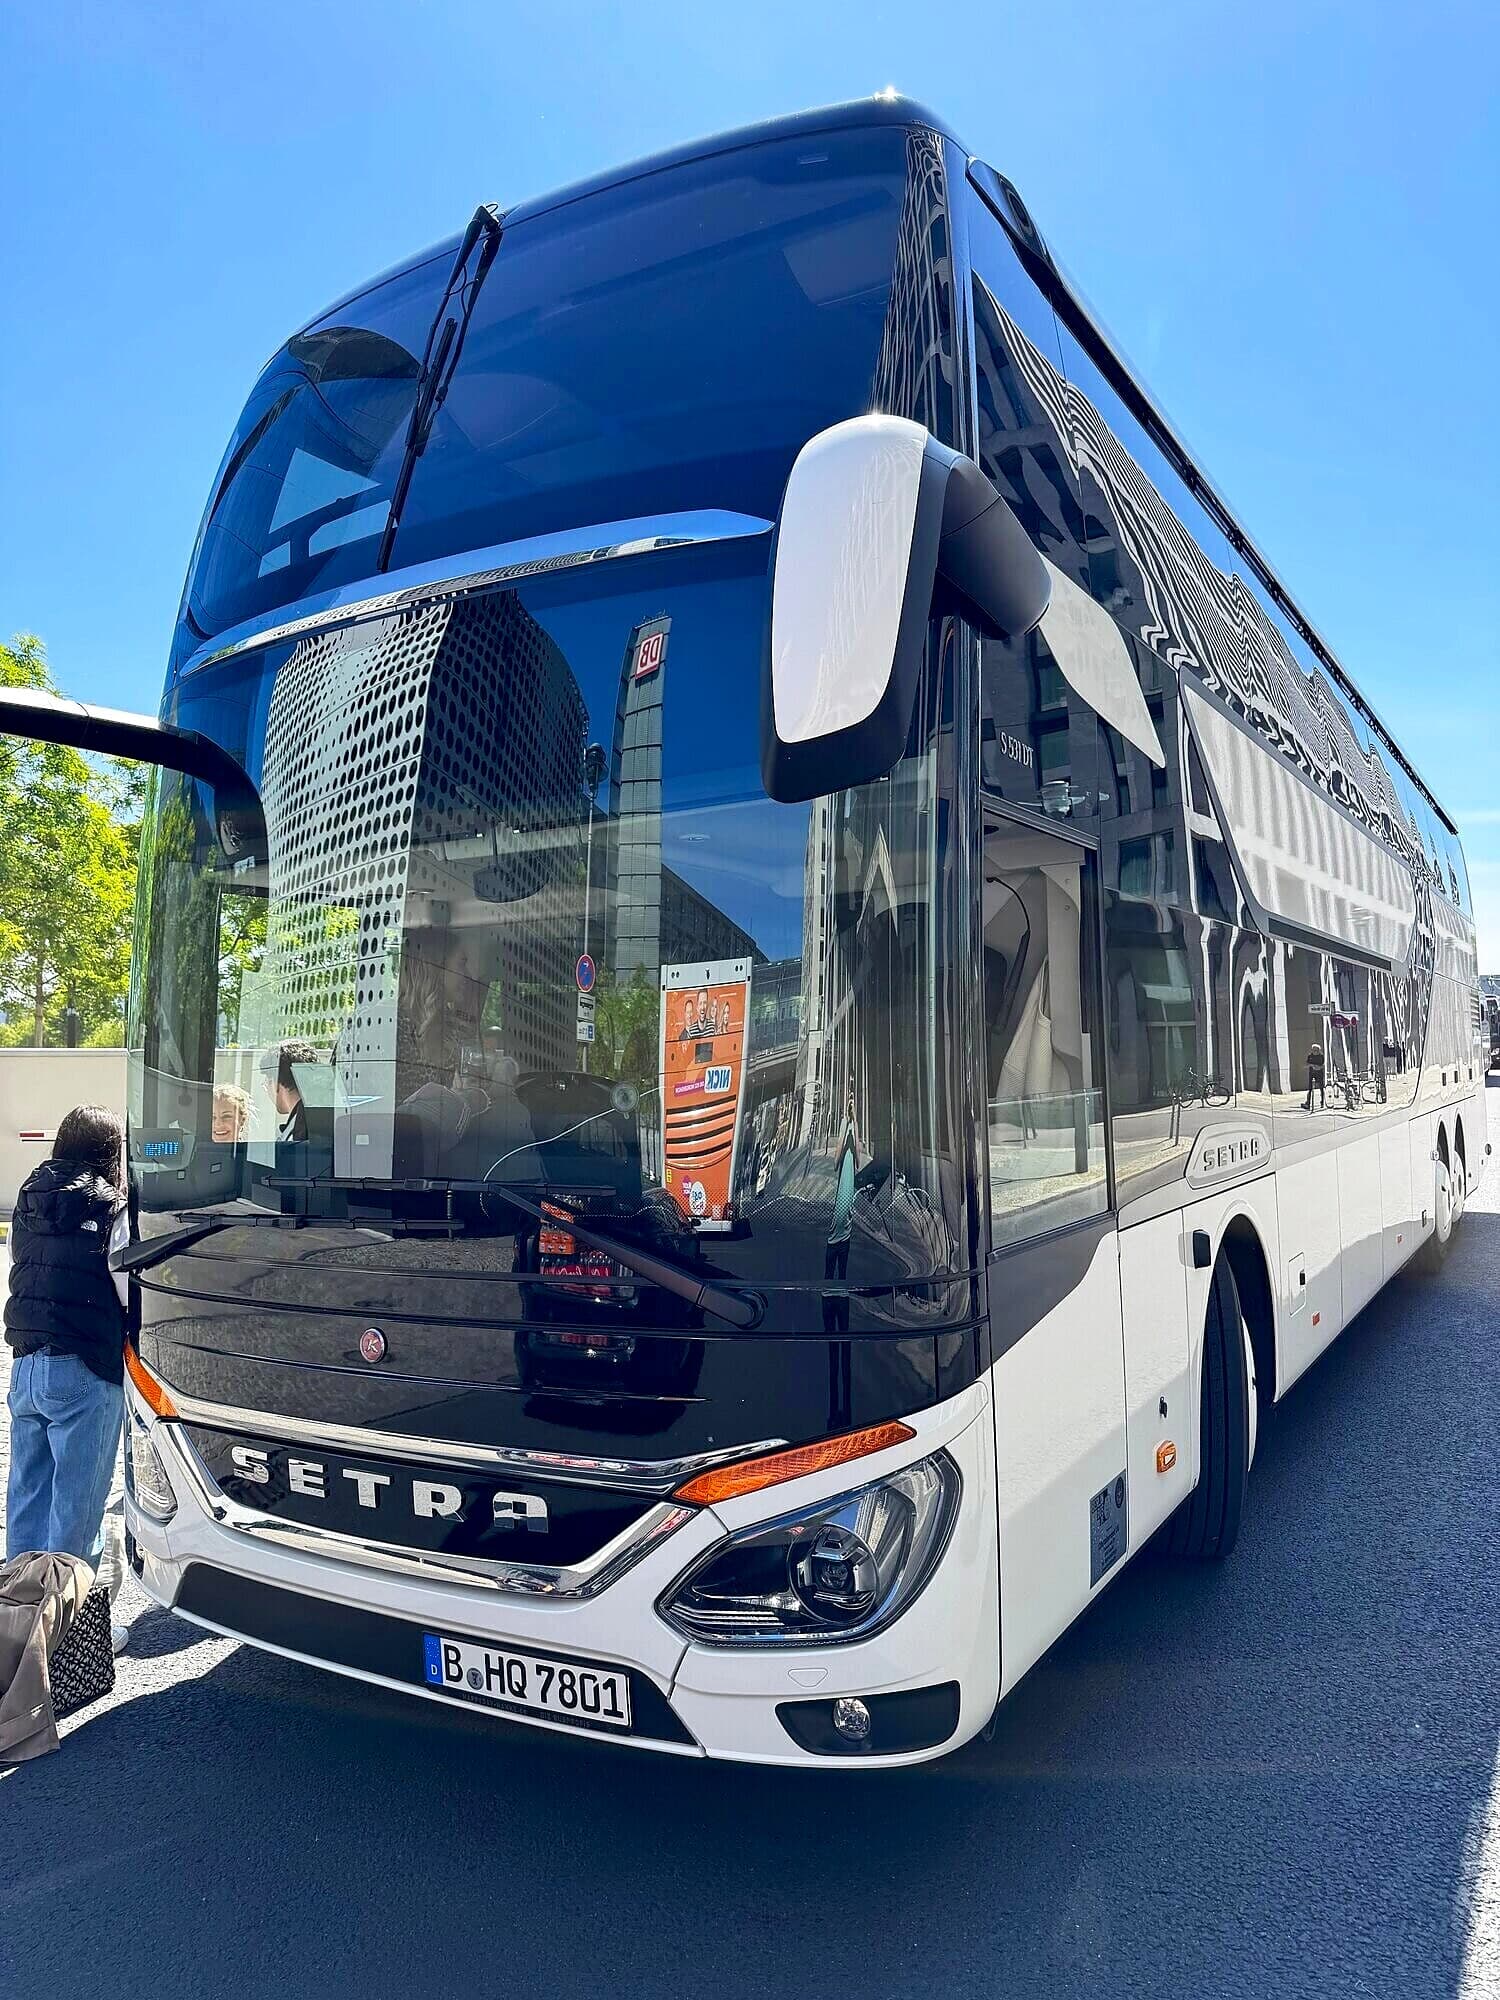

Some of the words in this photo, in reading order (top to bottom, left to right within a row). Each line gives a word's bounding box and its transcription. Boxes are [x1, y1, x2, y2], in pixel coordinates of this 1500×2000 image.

[1001, 731, 1007, 754] S
[1008, 735, 1021, 763] 531
[1022, 743, 1034, 769] DT
[1203, 1137, 1260, 1171] SETRA
[231, 1446, 549, 1533] SETRA
[431, 1664, 438, 1675] D
[444, 1644, 463, 1682] B
[484, 1653, 528, 1699] HQ
[535, 1664, 624, 1719] 7801
